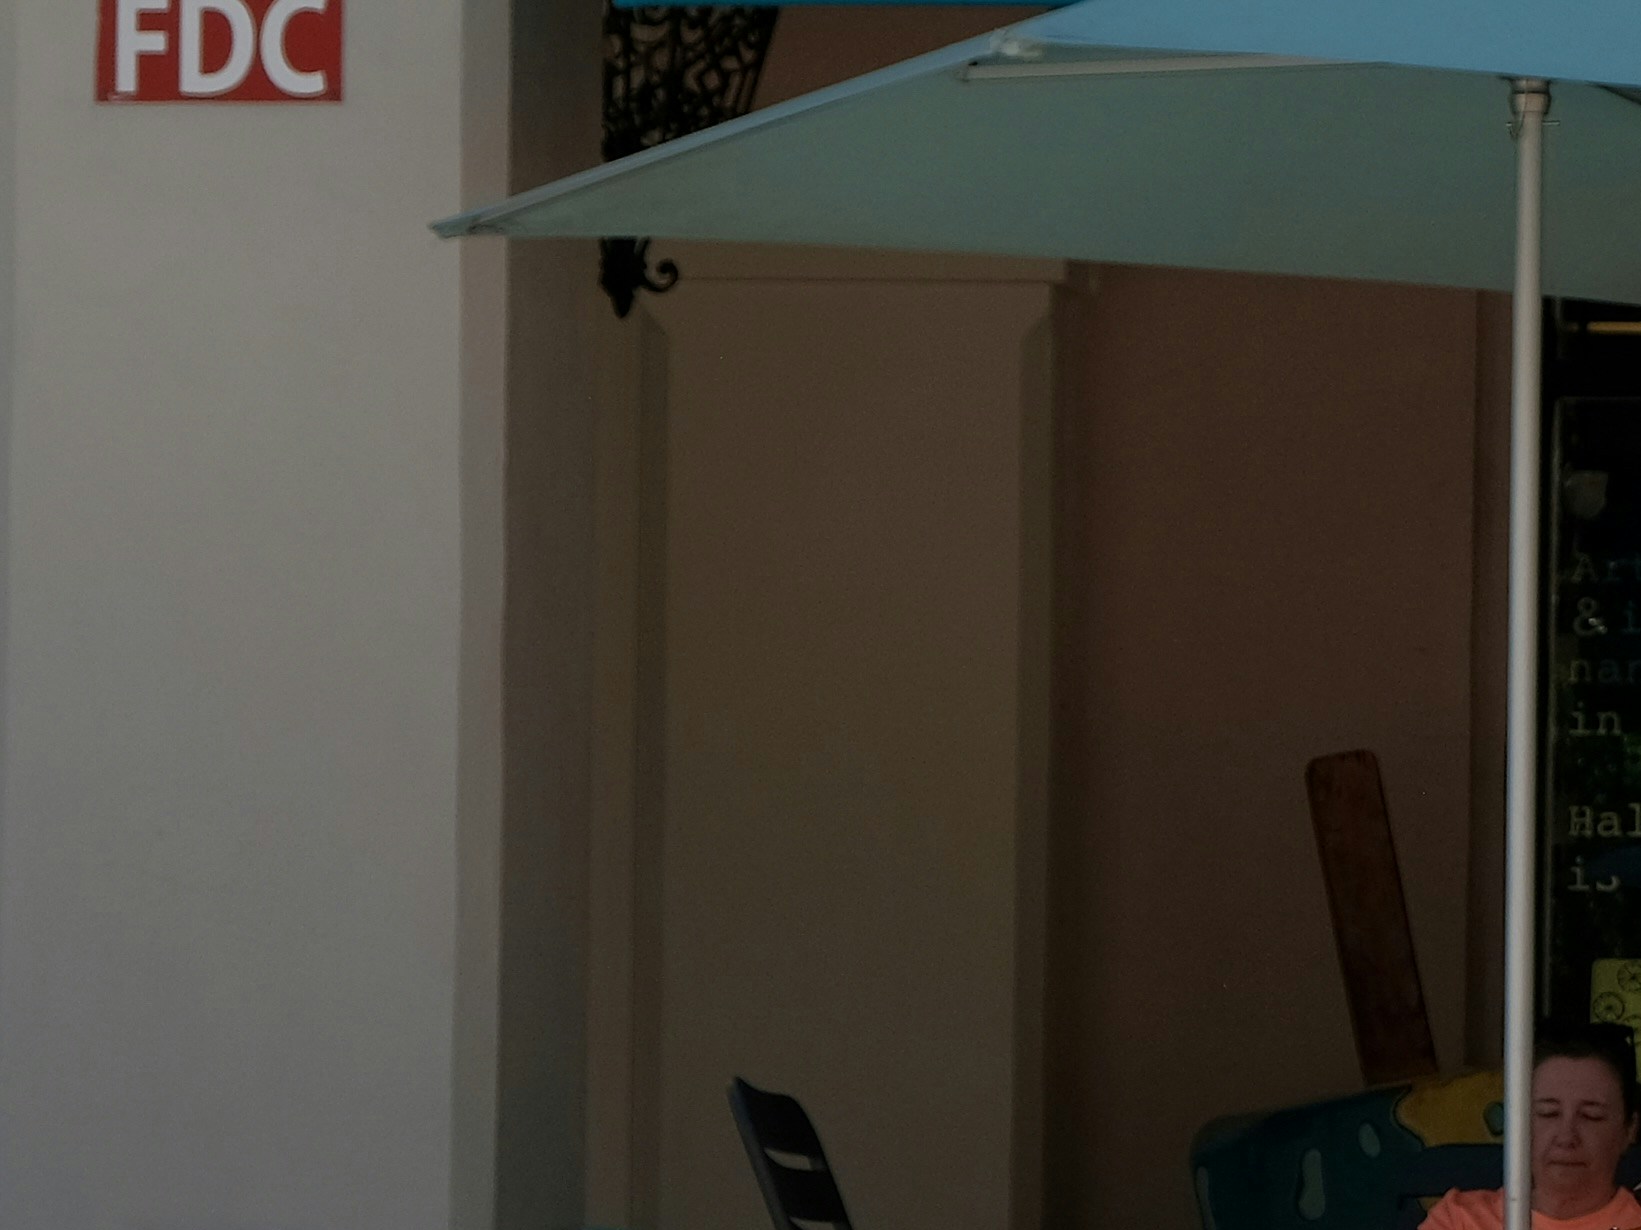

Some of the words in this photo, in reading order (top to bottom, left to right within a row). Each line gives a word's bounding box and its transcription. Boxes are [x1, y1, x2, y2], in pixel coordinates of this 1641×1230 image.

[115, 0, 328, 96] FDC
[1573, 597, 1607, 639] &
[1569, 702, 1622, 738] in
